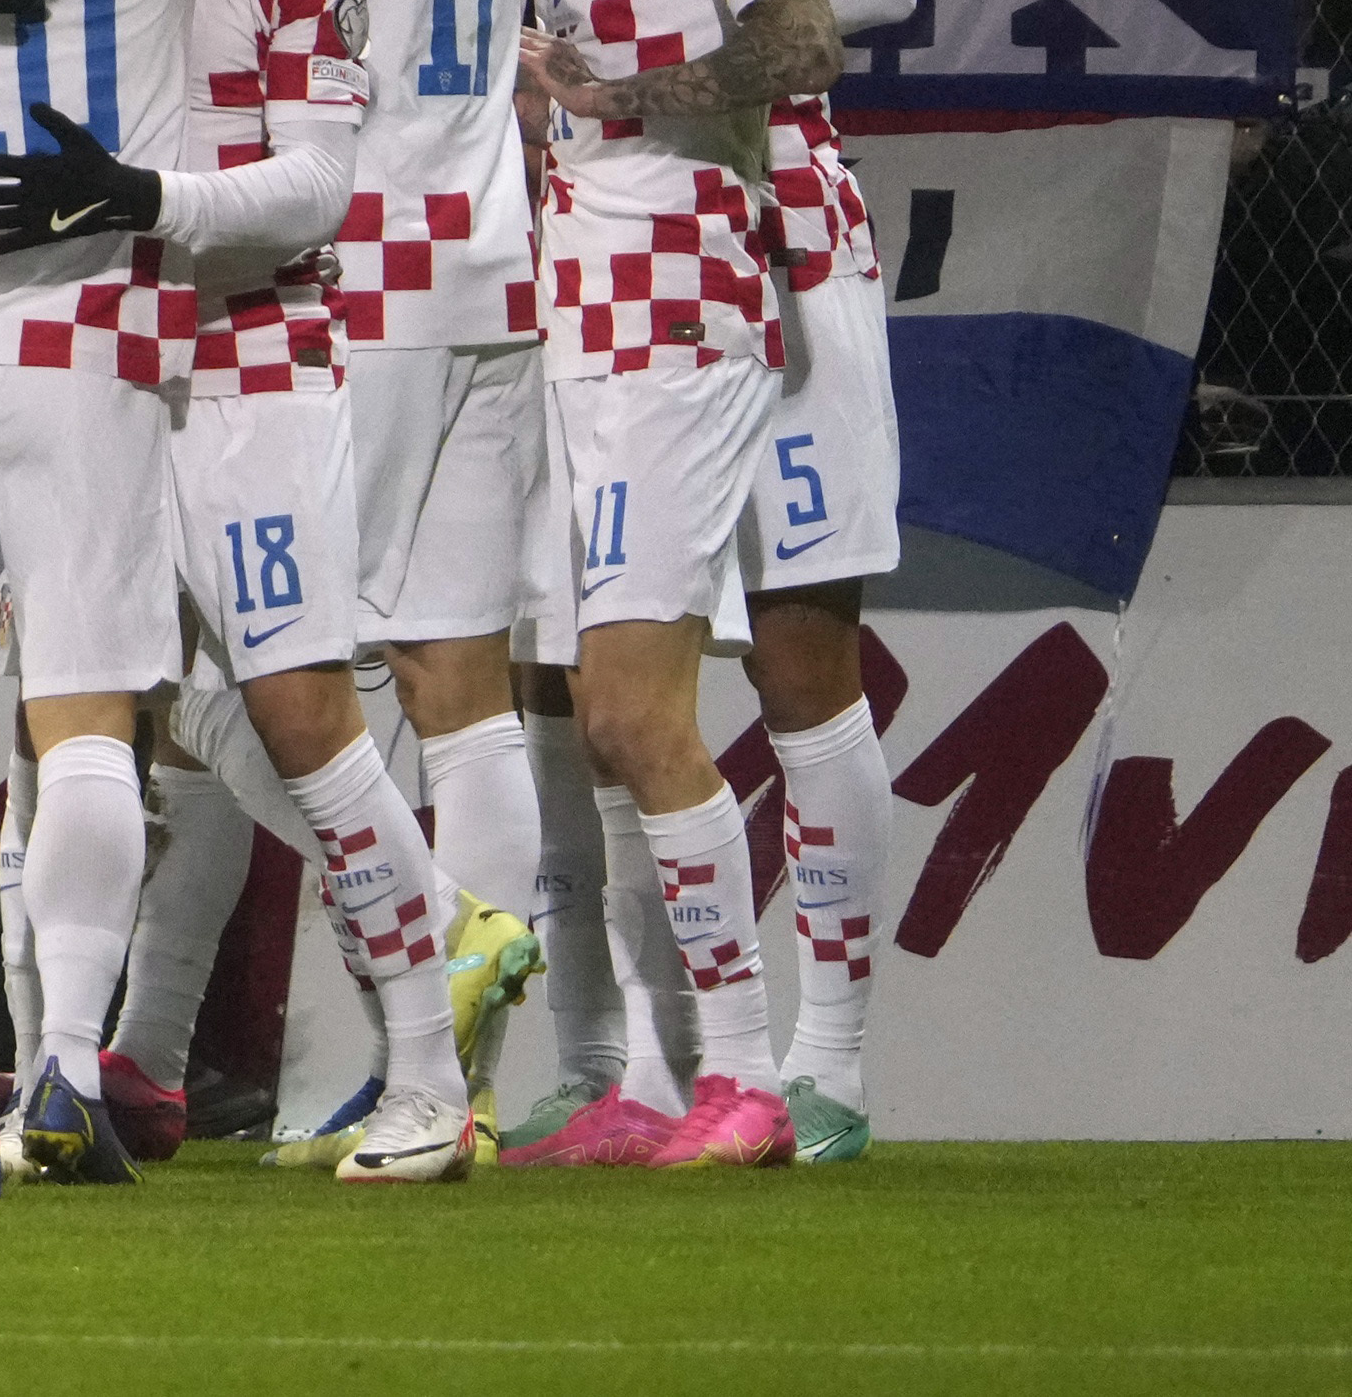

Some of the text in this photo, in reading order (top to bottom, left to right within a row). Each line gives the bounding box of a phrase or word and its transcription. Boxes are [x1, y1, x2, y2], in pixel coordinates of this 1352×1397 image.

[586, 481, 628, 570] 11
[775, 433, 828, 527] 5
[225, 514, 303, 614] 18
